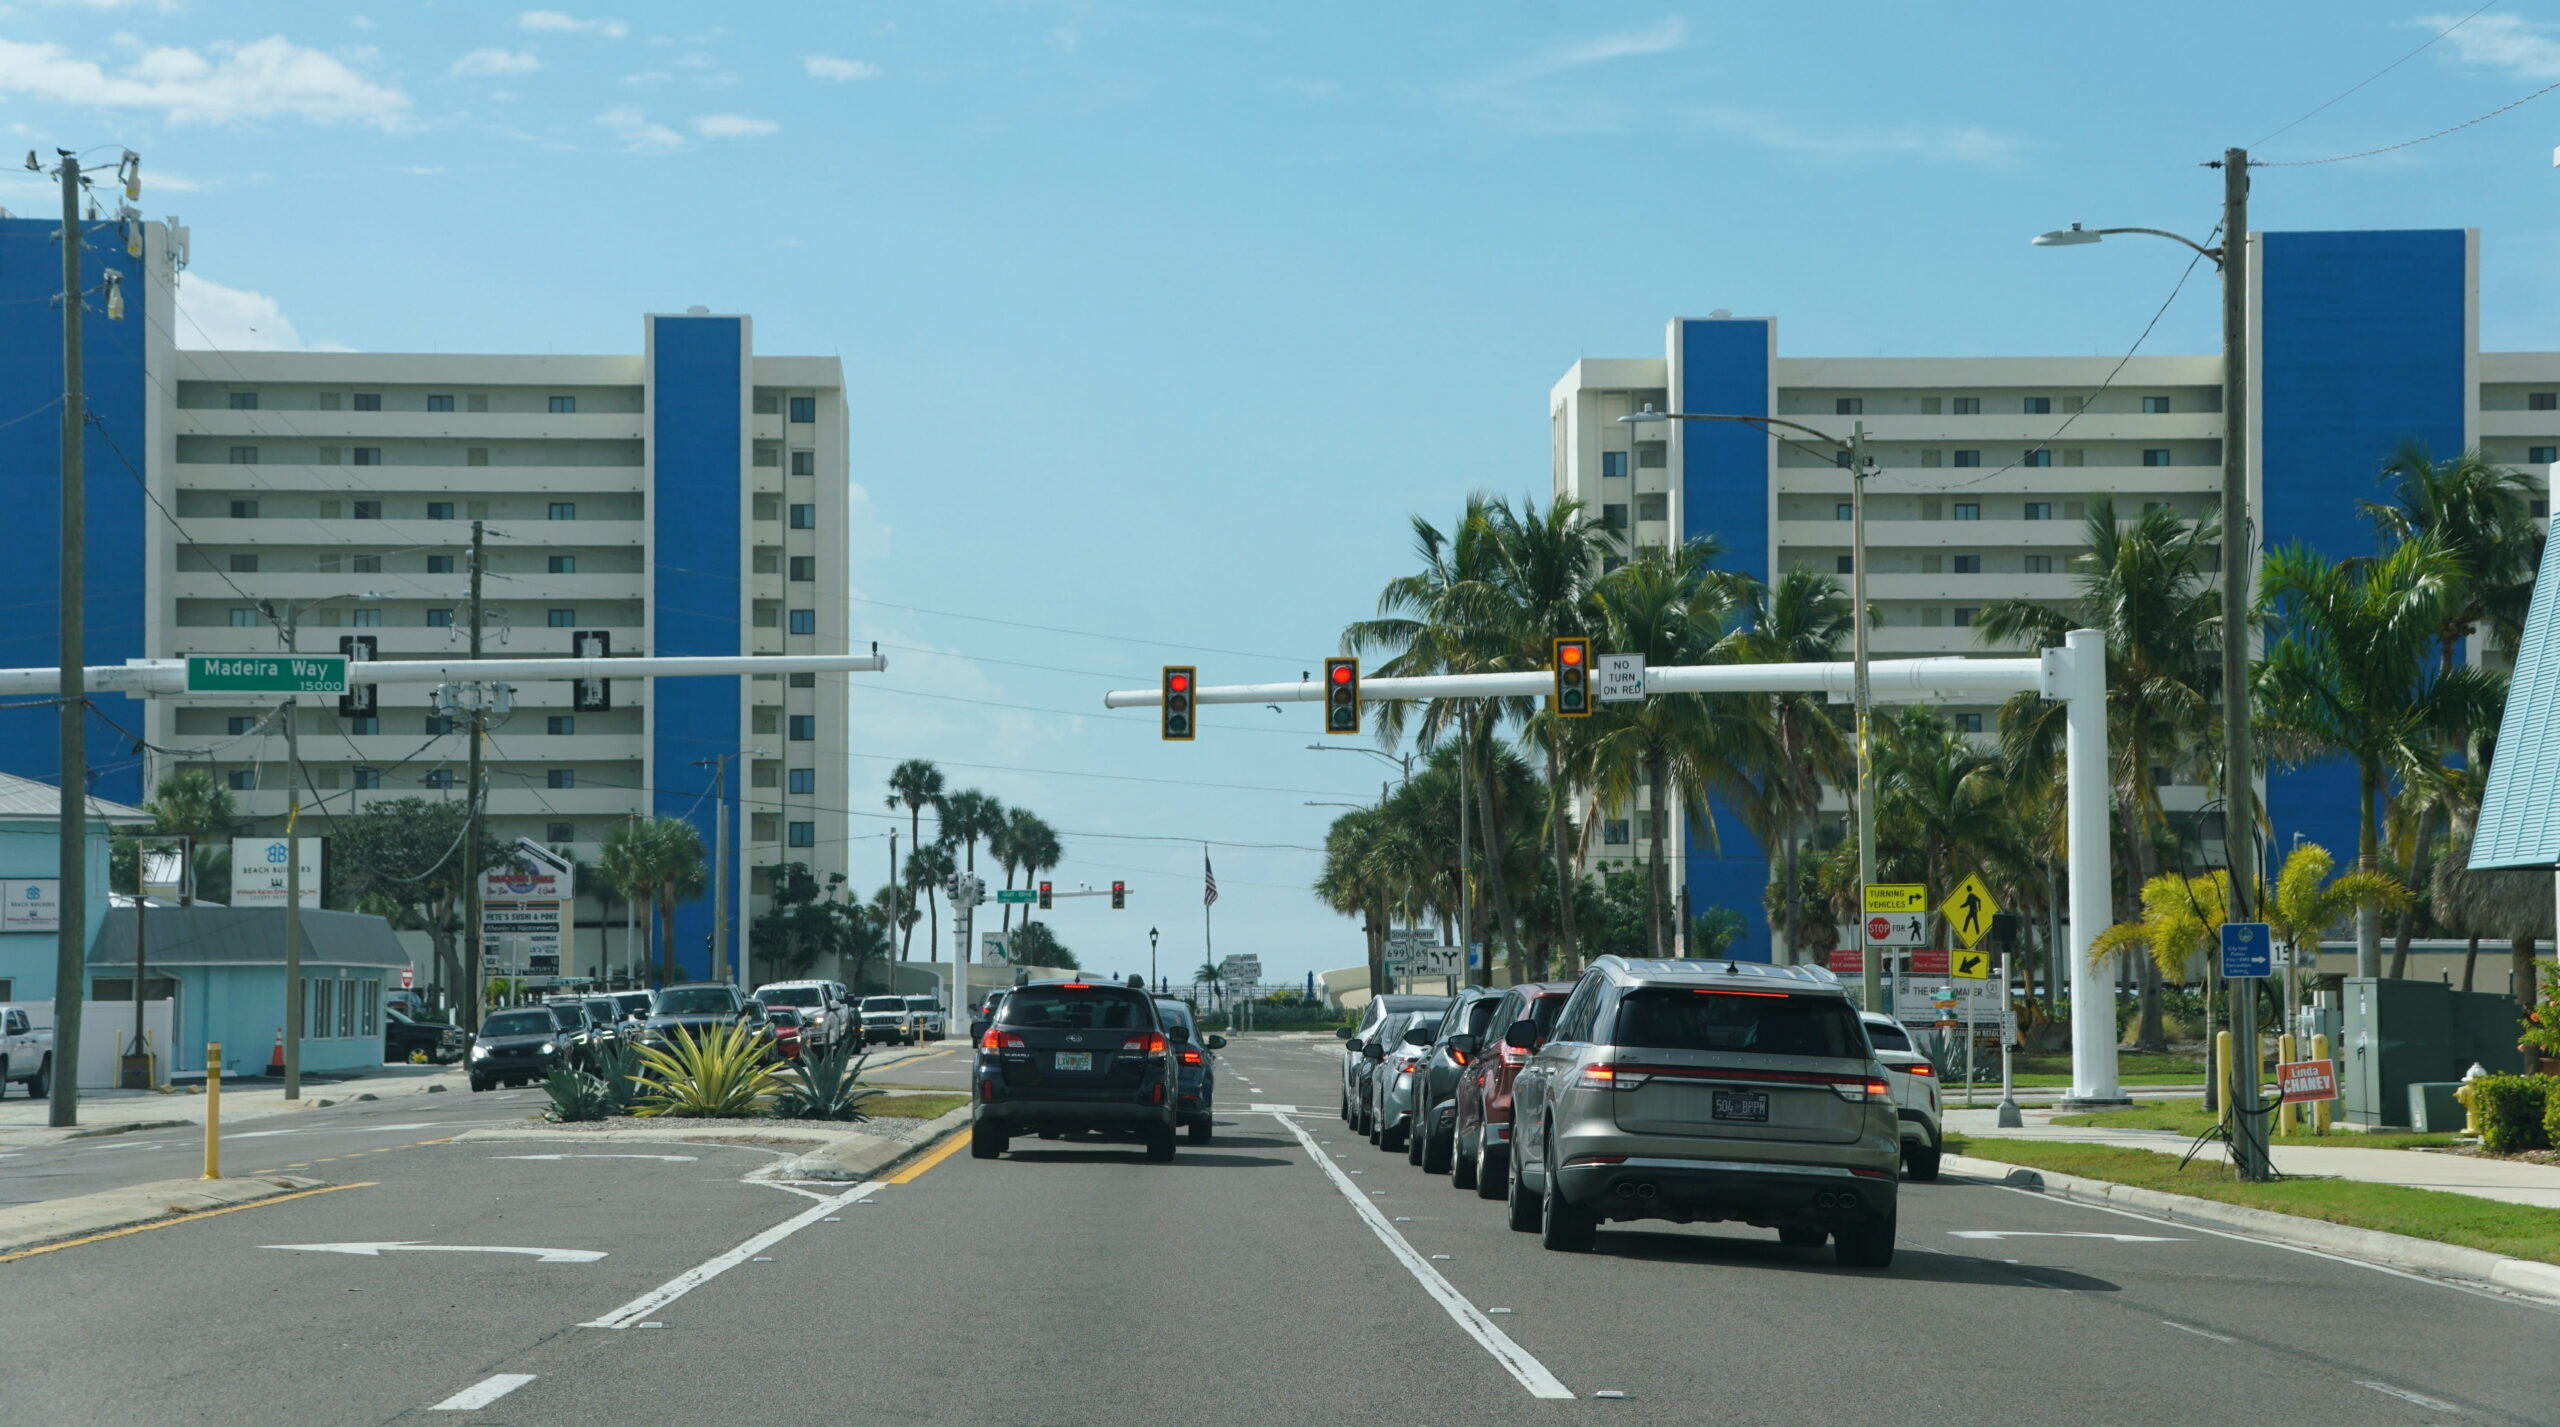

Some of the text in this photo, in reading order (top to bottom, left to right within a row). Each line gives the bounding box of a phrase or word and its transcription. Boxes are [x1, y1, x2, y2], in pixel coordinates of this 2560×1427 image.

[204, 659, 328, 681] Madeira Way
[1613, 660, 1630, 670] NO
[1609, 673, 1635, 682] TURN
[300, 681, 342, 691] 15000
[1603, 684, 1641, 696] ON RED
[1869, 889, 1905, 898] TURNING
[1868, 900, 1906, 909] VEHICLES
[486, 913, 510, 921] PETE'S
[511, 913, 532, 921] SUSHI
[540, 912, 558, 920] POKE
[1868, 923, 1906, 933] STOP FOR
[1391, 930, 1410, 939] SOUTH
[1414, 930, 1434, 938] NORTH
[1387, 949, 1405, 958] 699
[1914, 986, 1929, 996] THE
[2291, 1065, 2319, 1078] Linda
[2283, 1075, 2331, 1094] CHANEY
[1716, 1099, 1734, 1112] 504
